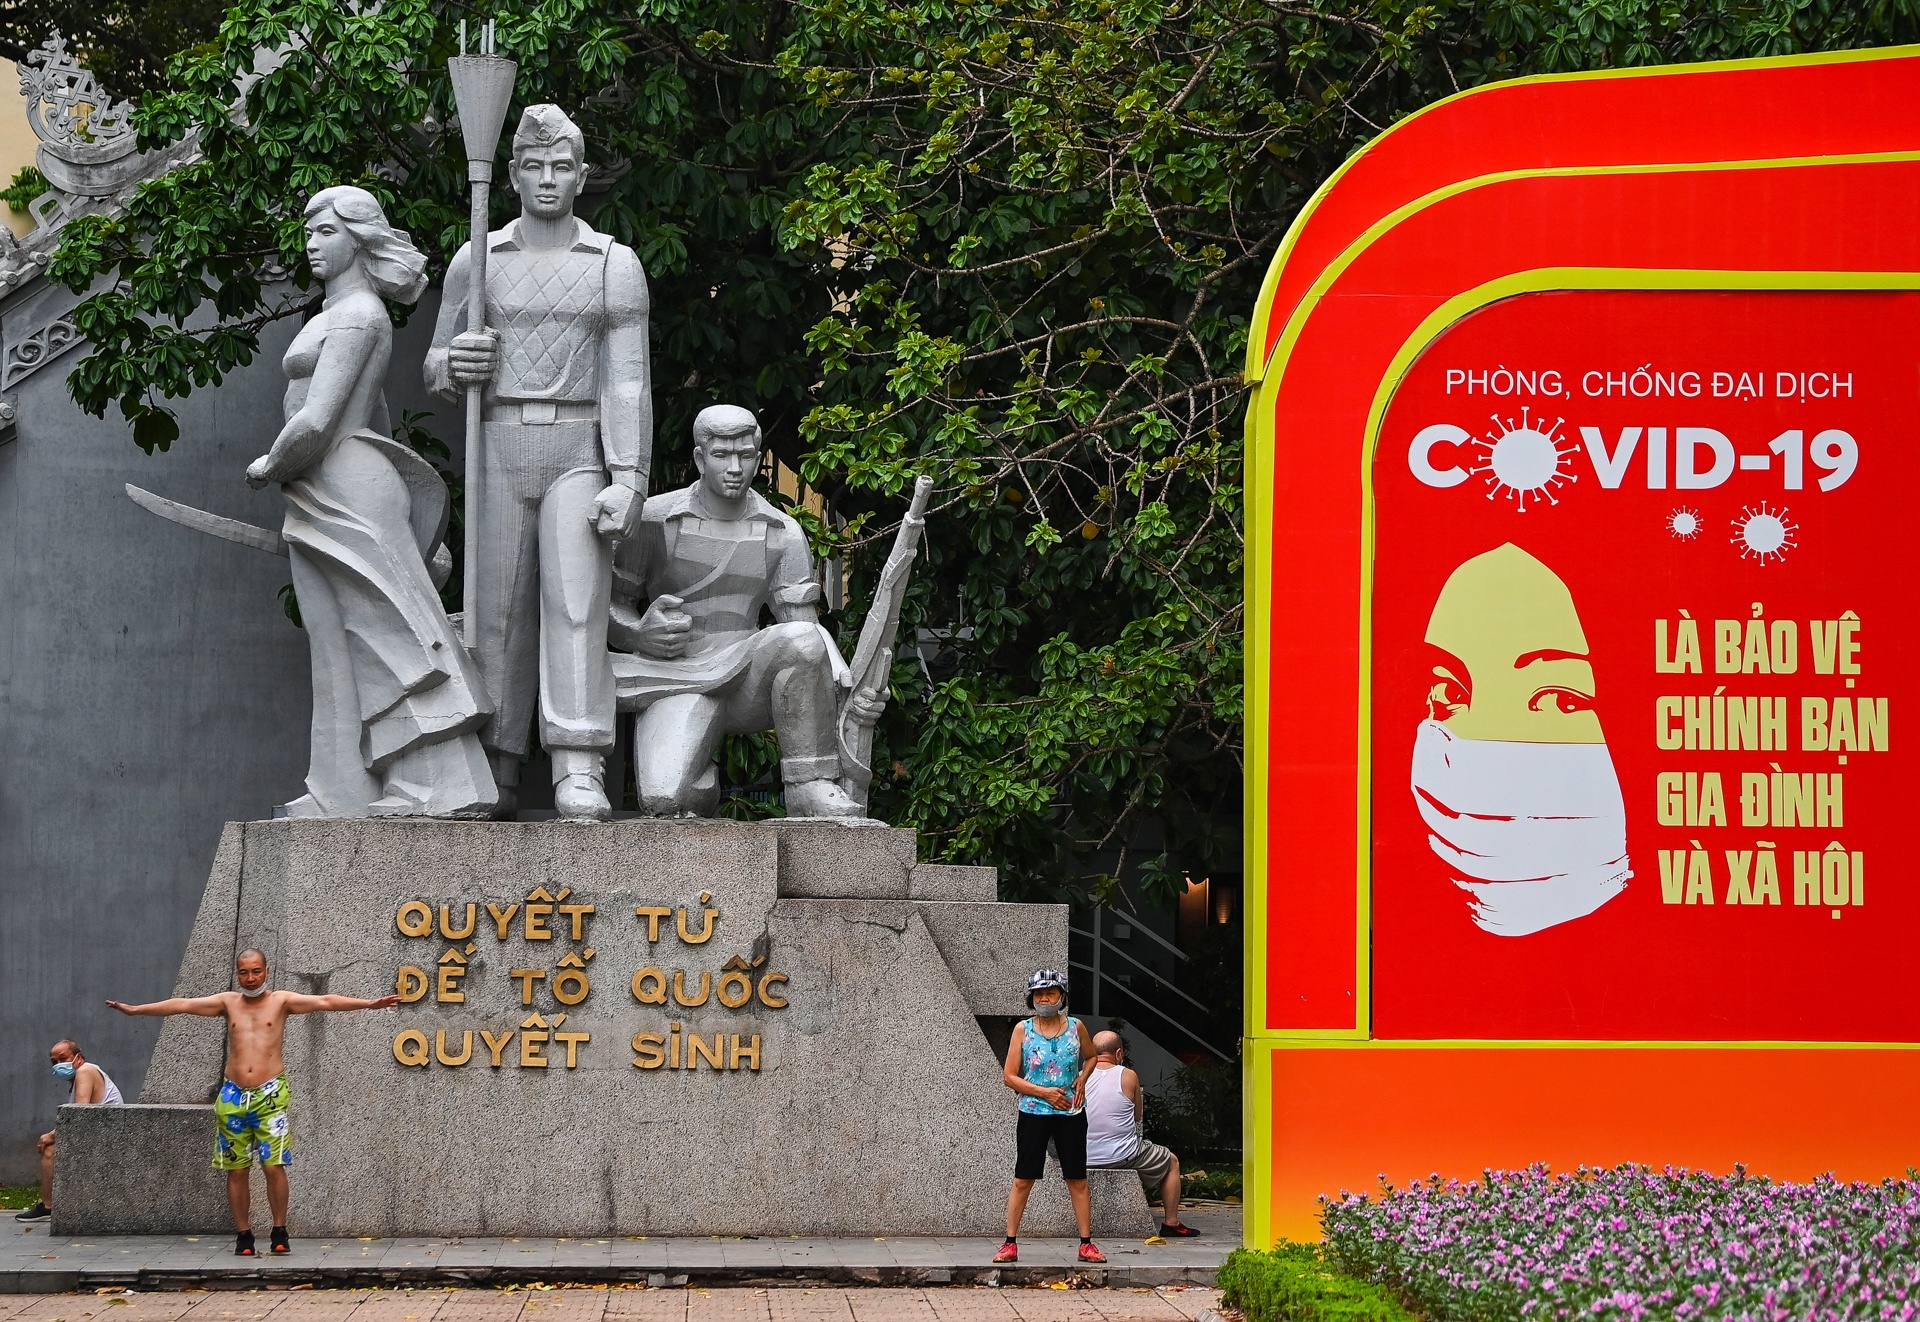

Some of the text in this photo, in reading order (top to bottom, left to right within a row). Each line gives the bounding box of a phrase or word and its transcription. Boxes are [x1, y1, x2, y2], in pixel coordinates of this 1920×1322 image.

[1445, 363, 1854, 404] PHÒNG, CHỐNG ĐẠI DỊCH
[1408, 406, 1859, 512] COVID-19
[1655, 602, 1861, 688] LÀ BẢO VỆ
[1656, 686, 1889, 765] CHÍNH BẠN
[1656, 762, 1844, 827] GIA ĐÌNH
[1657, 839, 1864, 920] VÀ XÃ HỘI
[396, 885, 595, 941] QUYẾT
[631, 954, 790, 1009] QUỐC
[392, 1012, 591, 1069] QUYẾT
